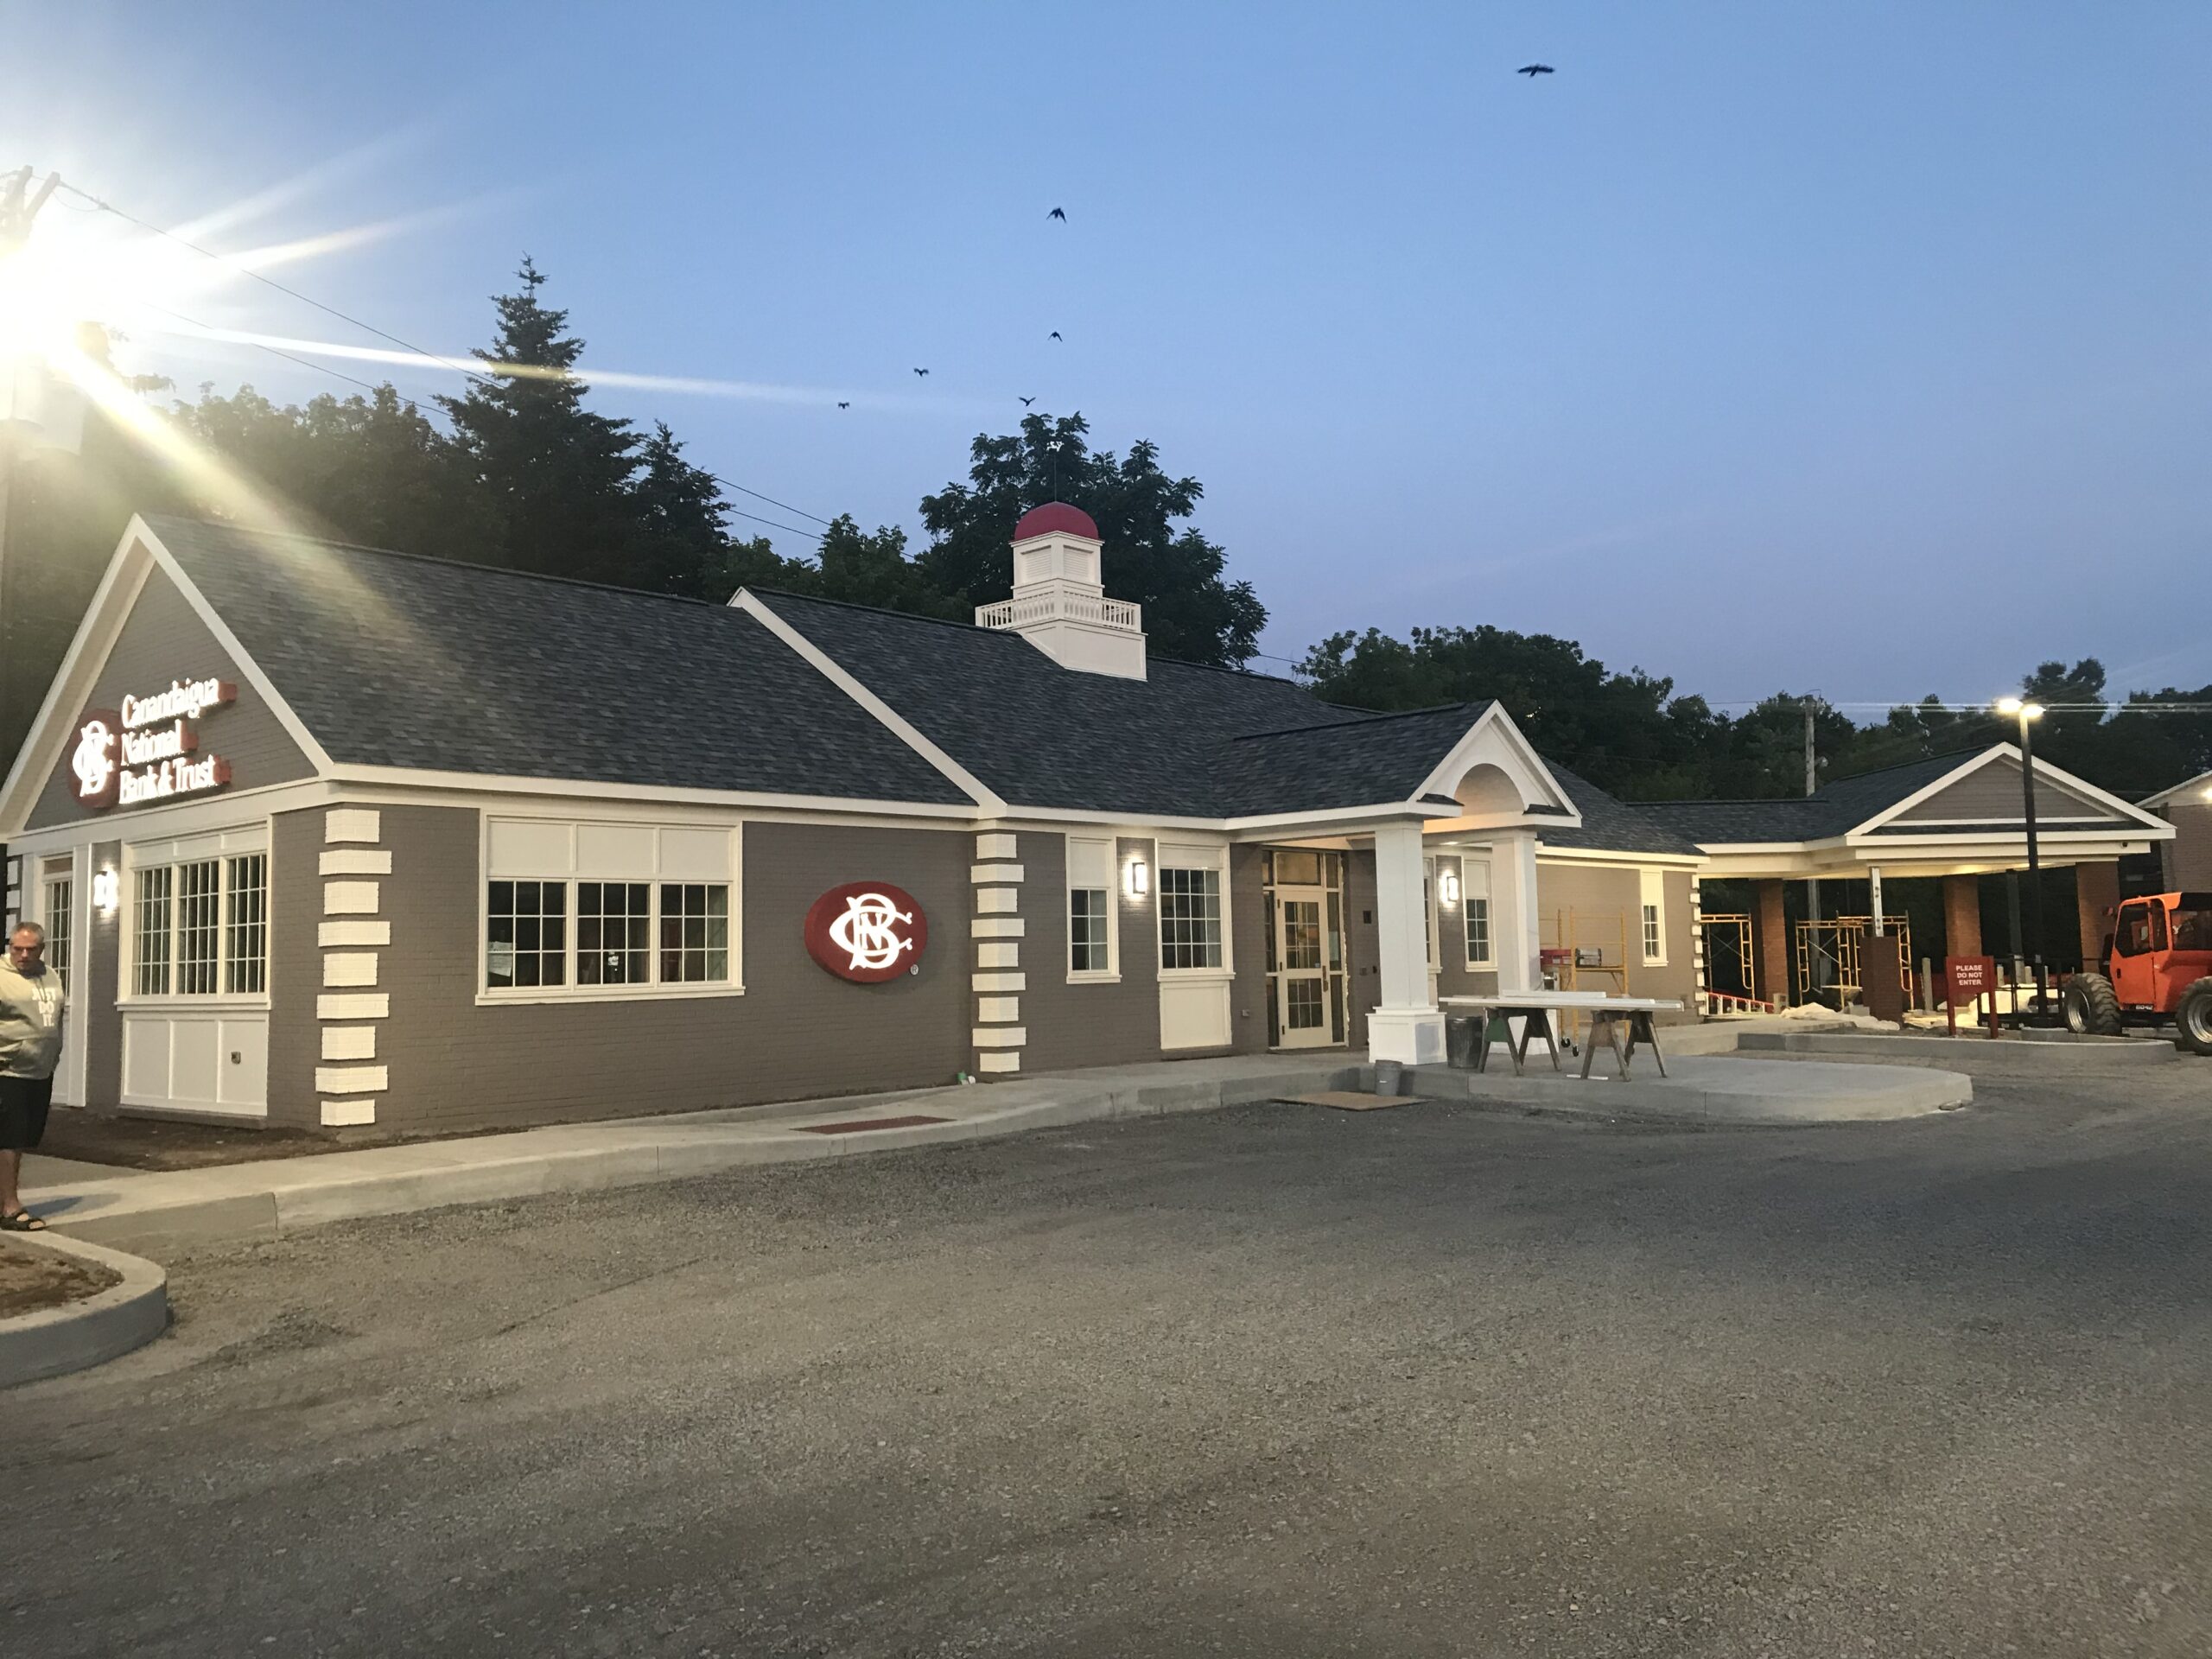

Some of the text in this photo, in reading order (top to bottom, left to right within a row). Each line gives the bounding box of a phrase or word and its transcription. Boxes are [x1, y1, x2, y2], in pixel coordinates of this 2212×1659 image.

[121, 677, 219, 728] Canandaigua
[120, 719, 183, 766] National
[119, 754, 216, 804] Bank & Trust
[32, 987, 56, 1001] JUST
[38, 1001, 54, 1014] DO
